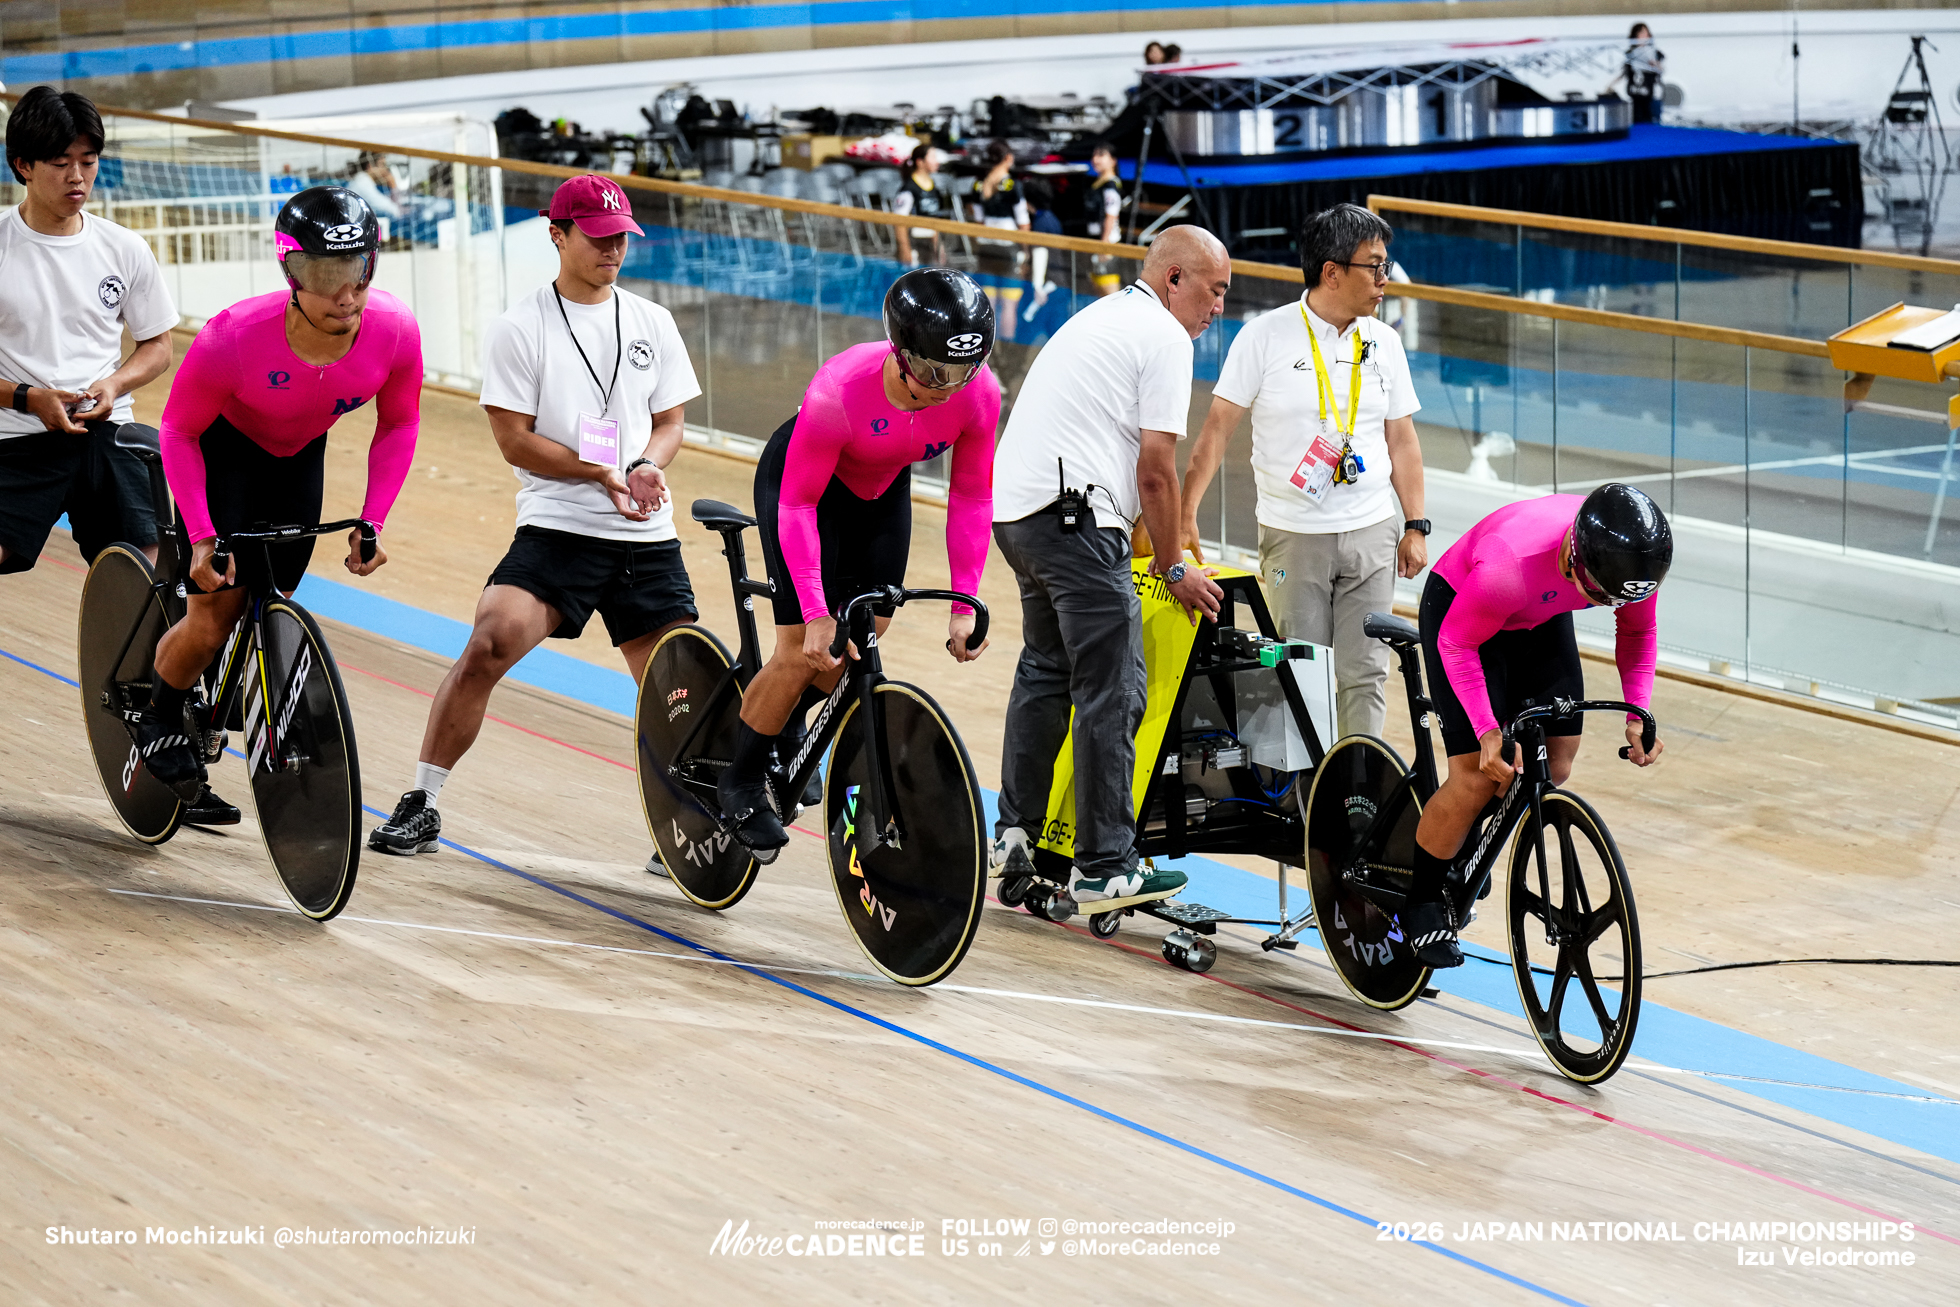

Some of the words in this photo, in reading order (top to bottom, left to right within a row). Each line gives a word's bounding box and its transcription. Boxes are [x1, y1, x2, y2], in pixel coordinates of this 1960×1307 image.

[1273, 114, 1303, 147] 2
[326, 241, 365, 250] Kabuto
[583, 431, 616, 448] RIDER
[788, 666, 850, 783] BRIDGESTONE
[1464, 773, 1522, 884] BRIDGESTONE
